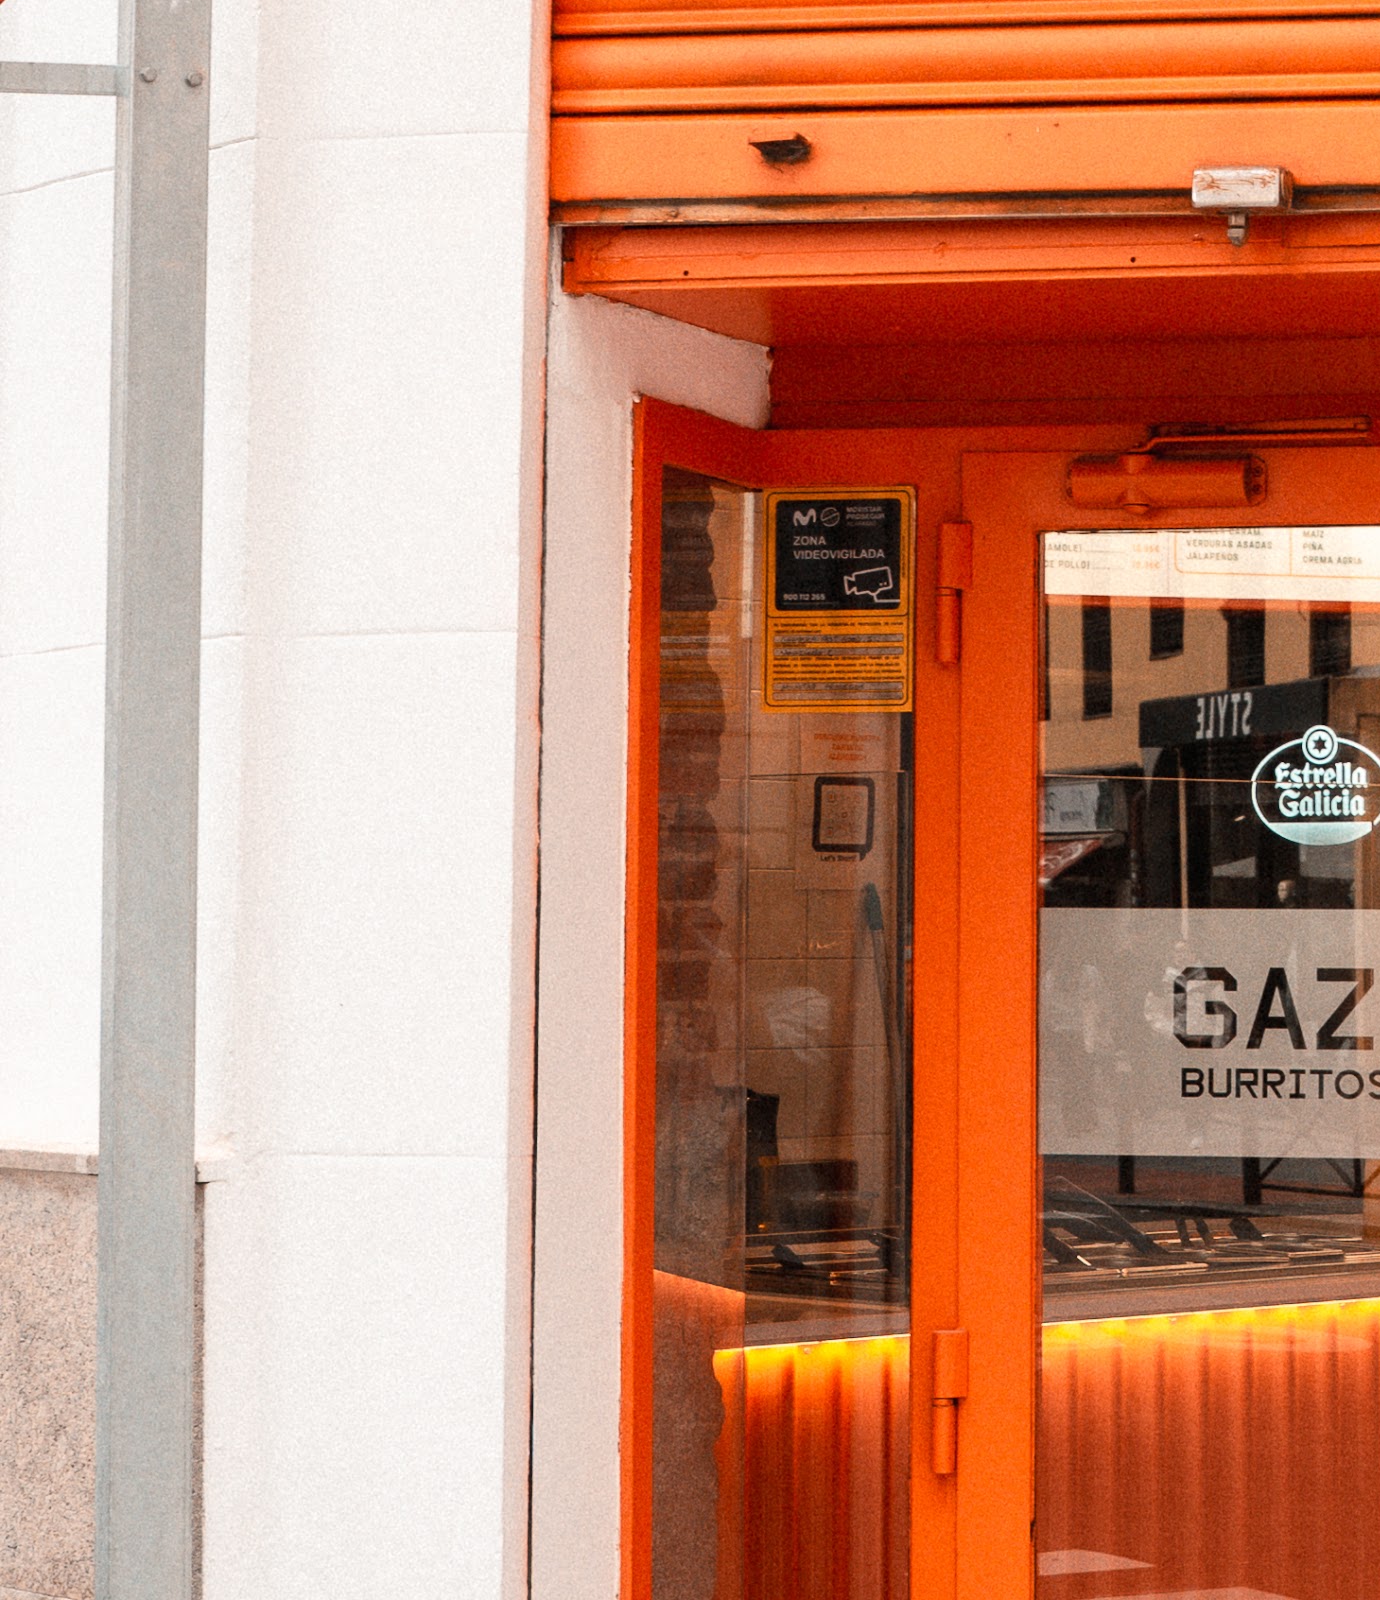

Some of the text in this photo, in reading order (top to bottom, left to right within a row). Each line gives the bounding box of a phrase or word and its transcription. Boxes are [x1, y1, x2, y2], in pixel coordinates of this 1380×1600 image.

[793, 536, 826, 546] ZONA
[1186, 539, 1273, 549] VERDURAS ASADAS
[793, 549, 885, 560] VIDEOVIGILADA
[1302, 555, 1333, 564] CREMA
[1274, 762, 1368, 789] Estrella
[1278, 789, 1366, 817] Galicia
